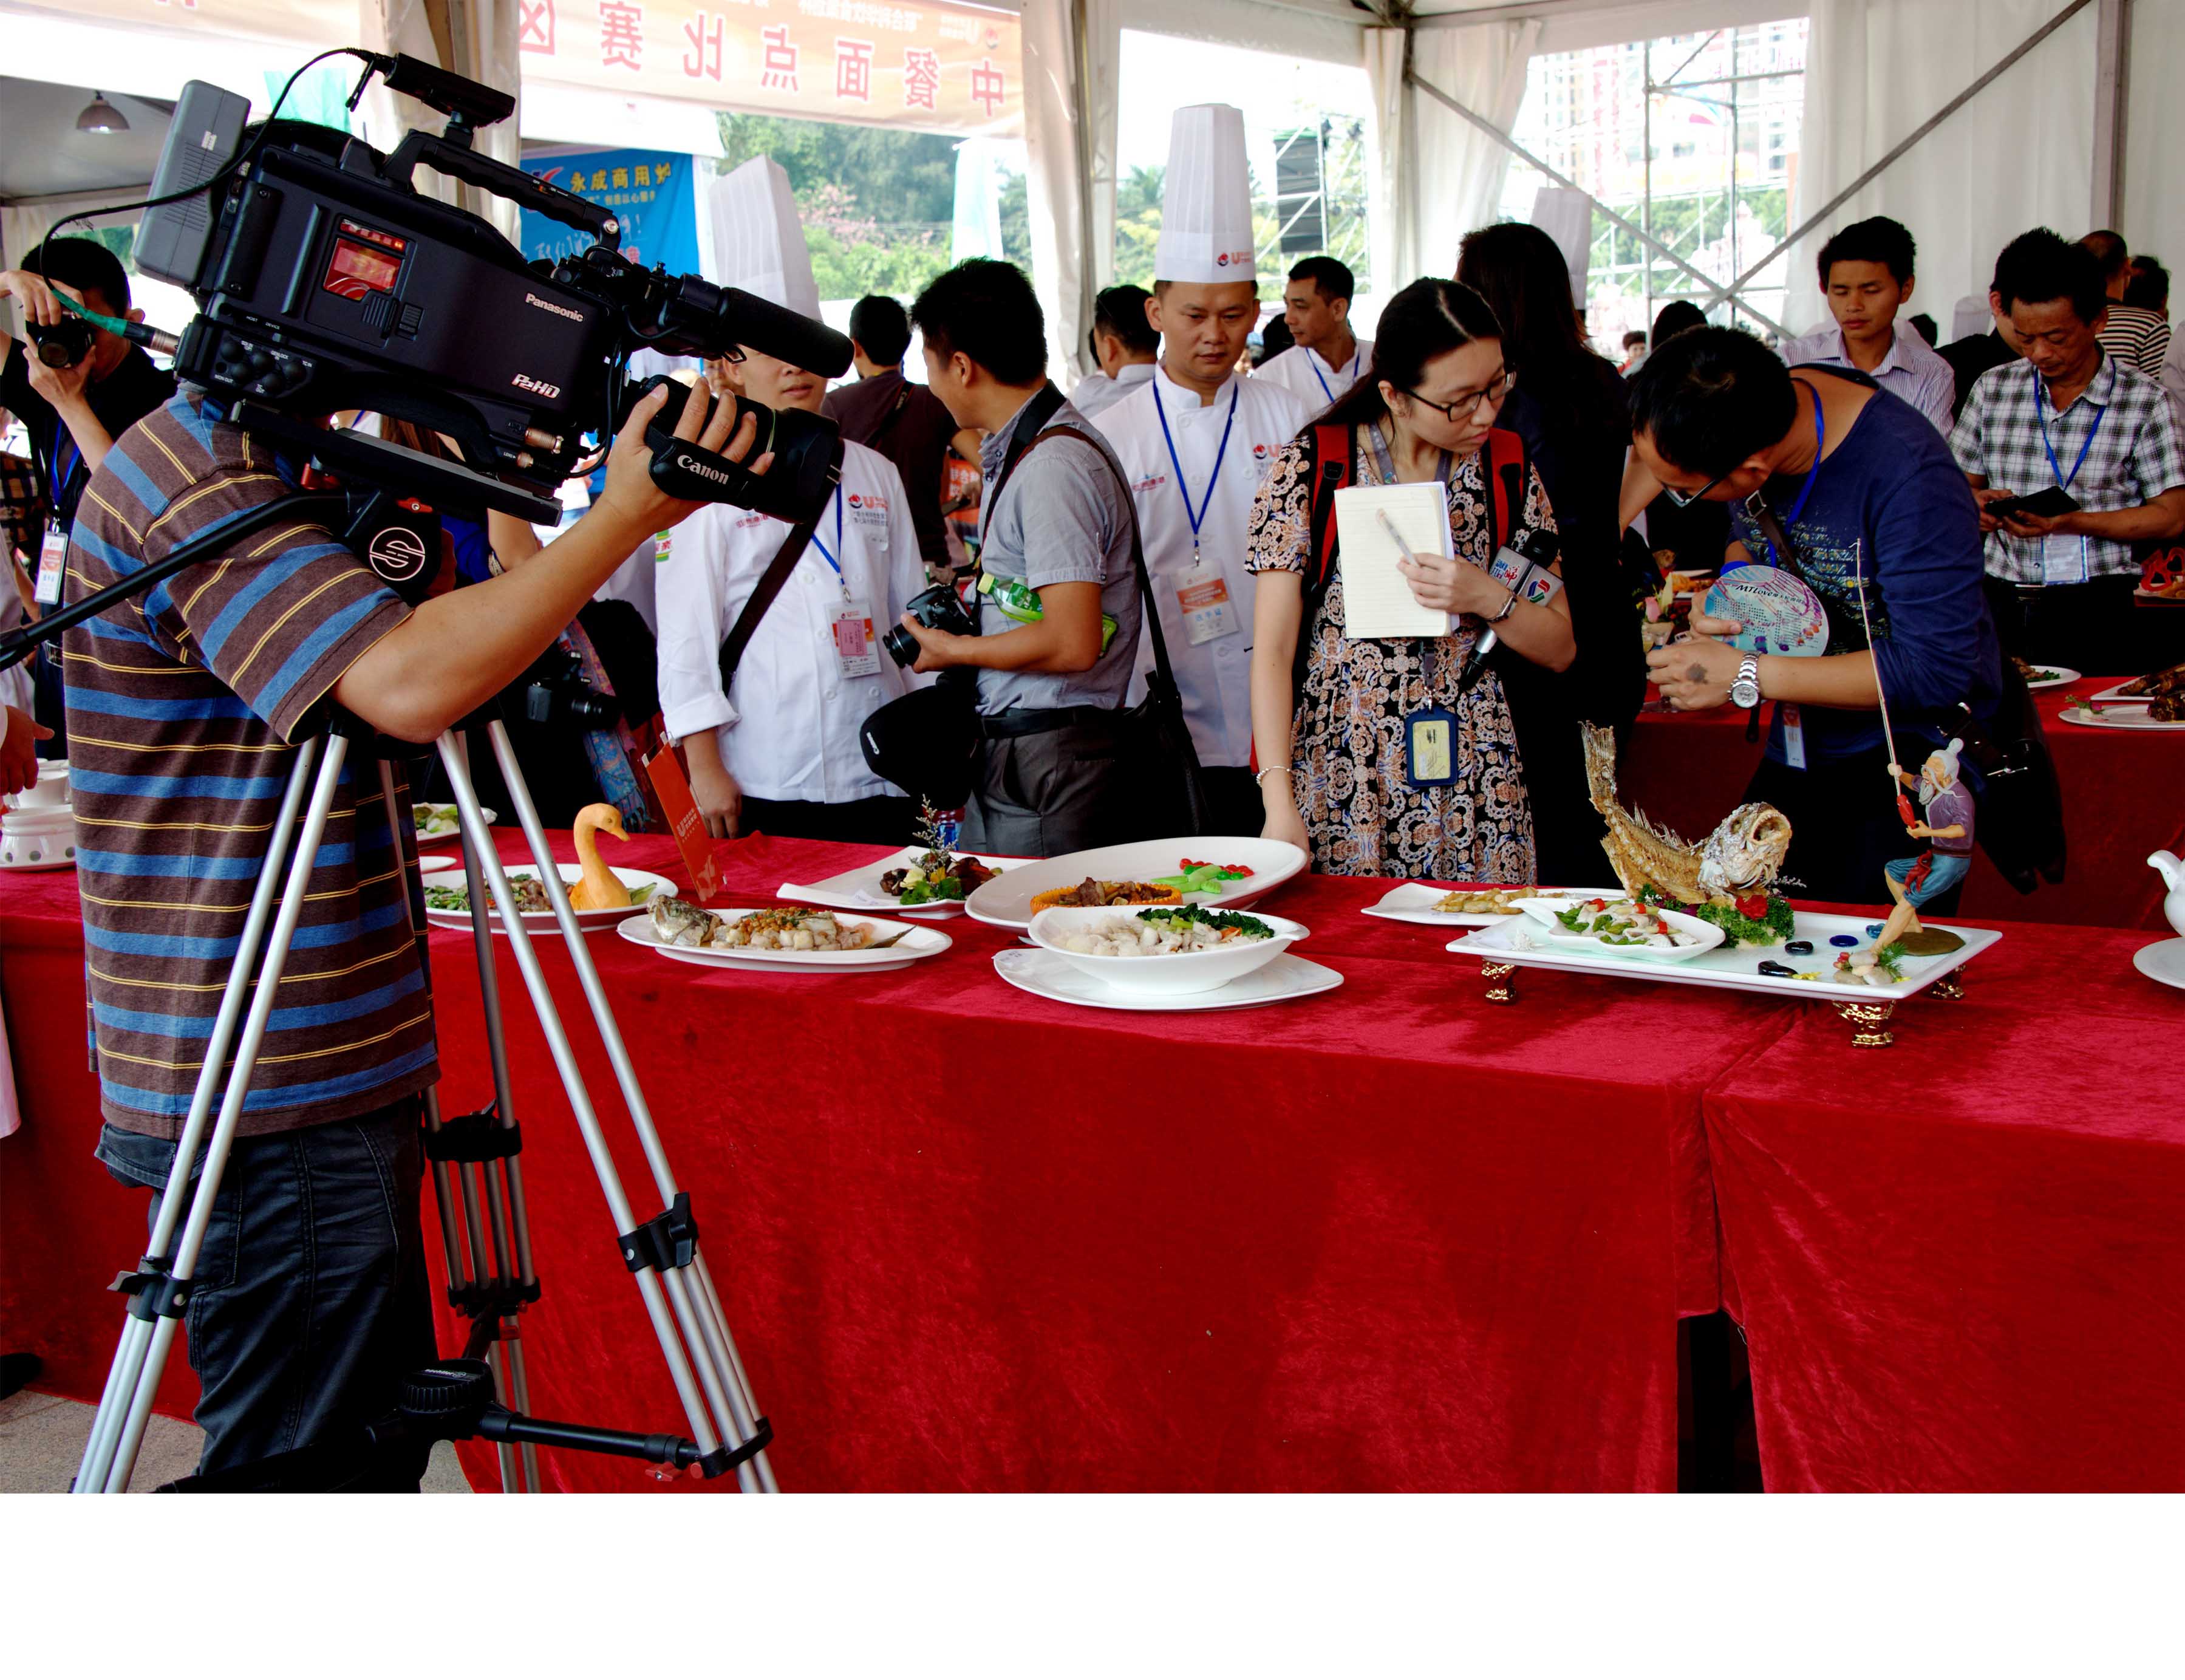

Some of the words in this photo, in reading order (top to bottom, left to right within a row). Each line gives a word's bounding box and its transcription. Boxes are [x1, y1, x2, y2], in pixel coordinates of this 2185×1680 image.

[526, 293, 584, 323] Panasonic
[511, 374, 561, 399] P2HD
[677, 455, 729, 485] Canon
